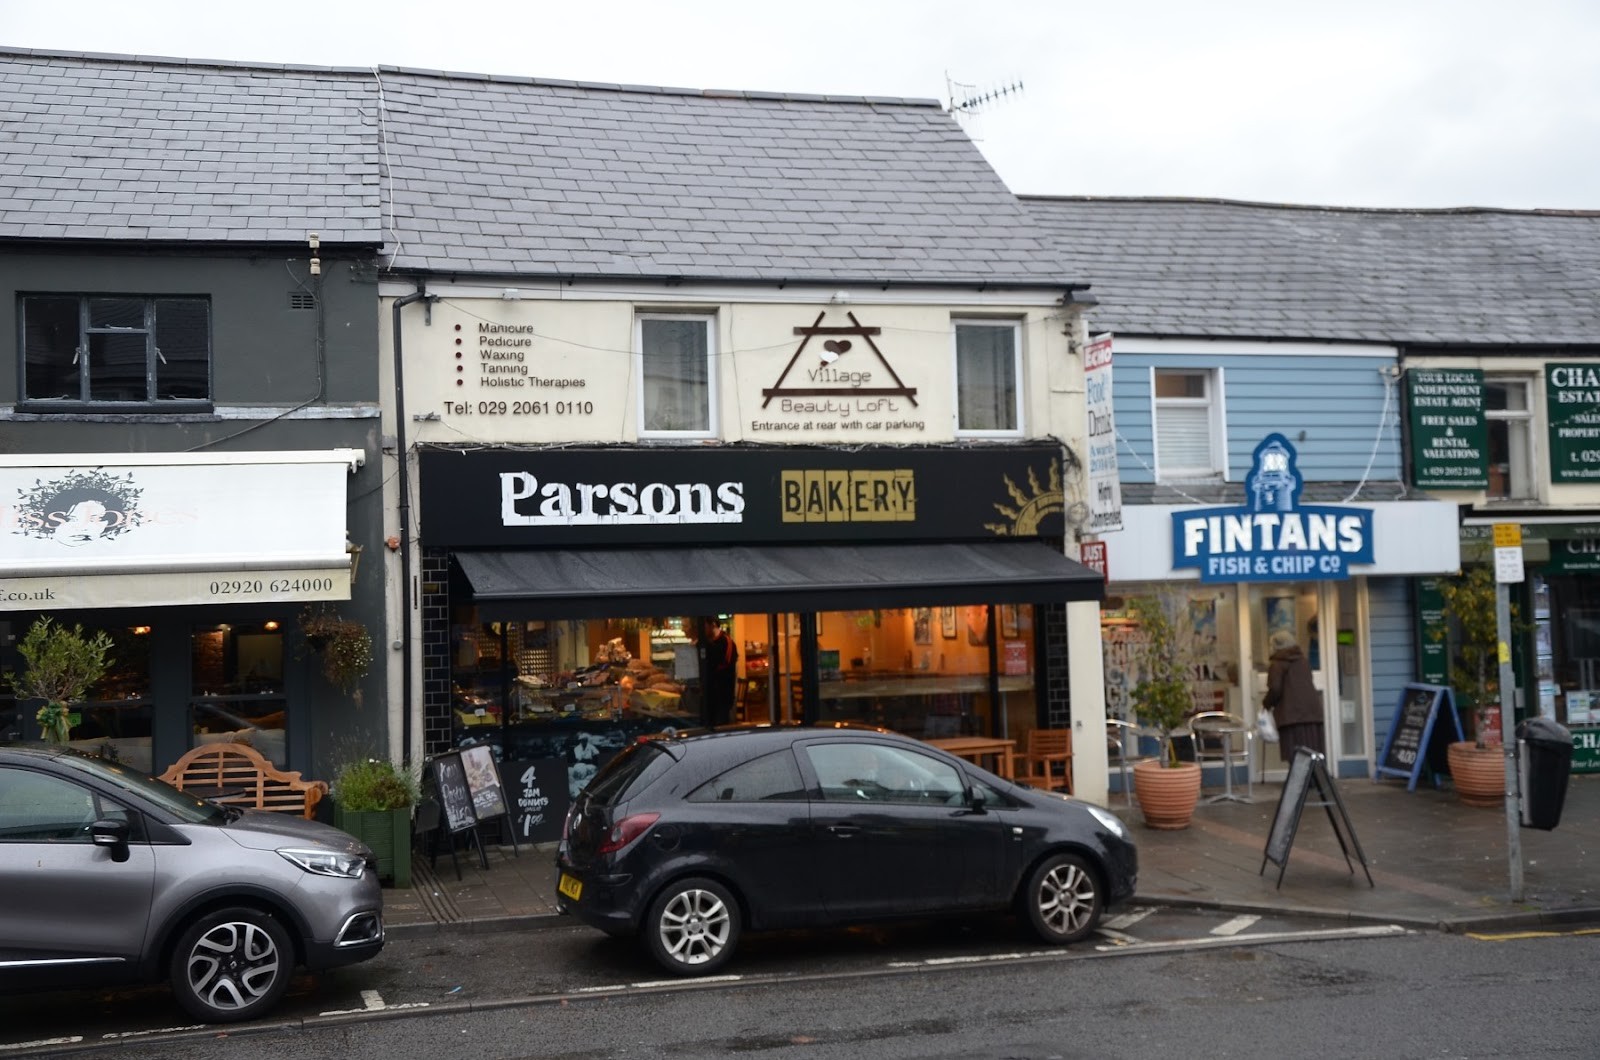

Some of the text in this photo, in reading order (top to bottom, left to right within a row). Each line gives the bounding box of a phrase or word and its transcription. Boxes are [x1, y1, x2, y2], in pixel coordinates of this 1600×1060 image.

[478, 322, 534, 334] Manicure
[479, 336, 532, 347] Pedicure
[480, 350, 525, 362] Waxing
[481, 363, 529, 375] Tanning
[480, 376, 586, 389] Holistic Therapies
[808, 368, 872, 388] Village
[1417, 373, 1477, 383] YOUR LOCAL
[1551, 367, 1600, 388] CHA
[1413, 385, 1481, 395] INDEPENDENT
[1414, 396, 1481, 407] ESTATE AGENT
[444, 401, 593, 415] Tel: 029 2061 0110
[782, 399, 899, 417] Beauty Loft
[752, 420, 925, 431] Entrance at rear with car parking
[1421, 415, 1478, 426] FREE SALES
[1558, 428, 1600, 438] PROPERT
[1432, 437, 1469, 448] RENTAL
[1422, 448, 1480, 459] VALUATIONS
[499, 471, 913, 524] Parsons BAKERY
[1183, 513, 1363, 557] FINTANS
[1209, 556, 1250, 576] FISH
[1254, 556, 1269, 575] &
[1271, 555, 1315, 574] CHIP
[209, 577, 333, 596] 02920 624000
[520, 765, 537, 788] 4
[523, 788, 540, 798] JAM
[518, 796, 549, 807] DONUTS
